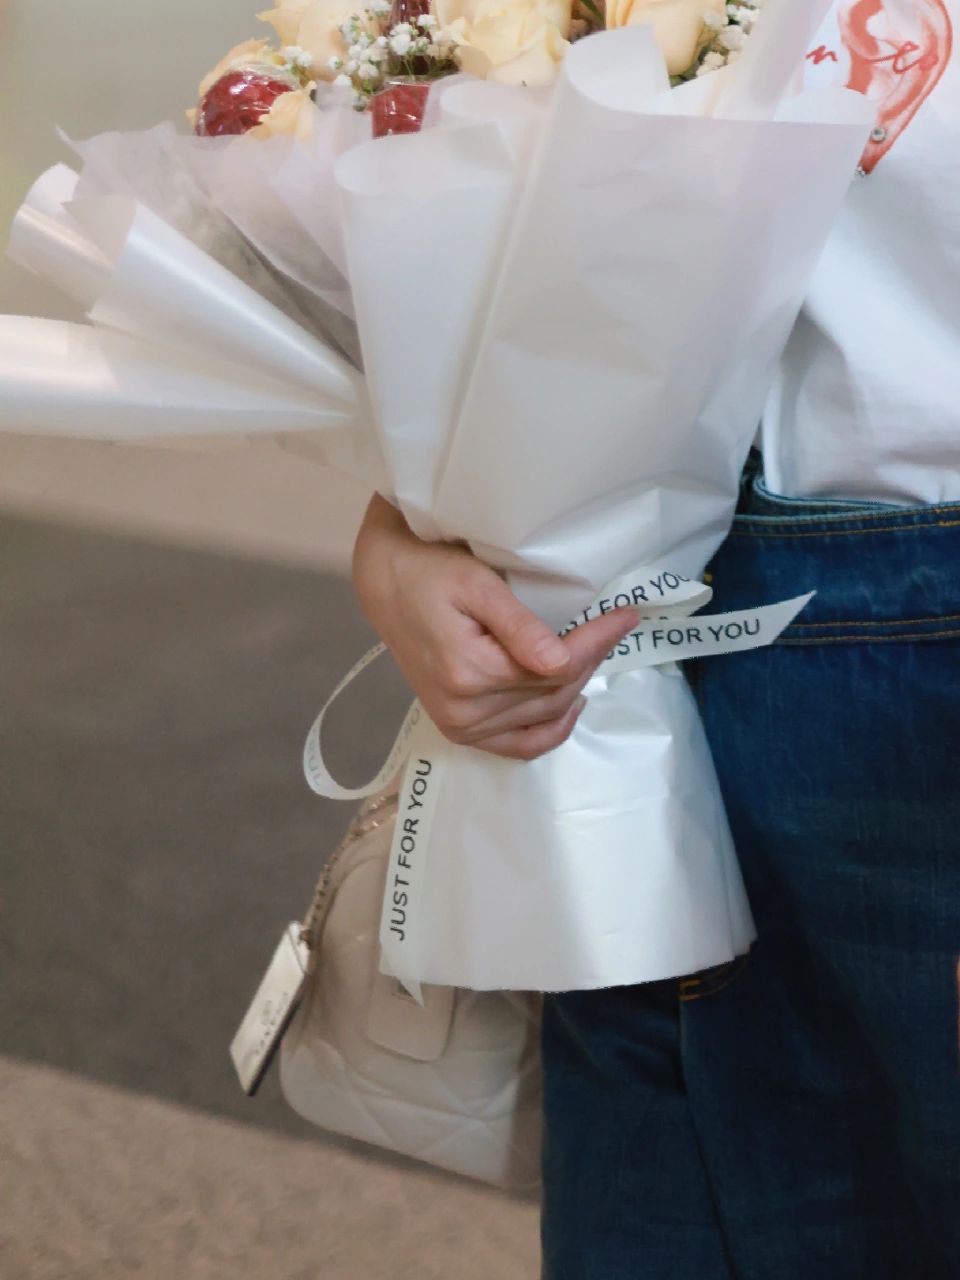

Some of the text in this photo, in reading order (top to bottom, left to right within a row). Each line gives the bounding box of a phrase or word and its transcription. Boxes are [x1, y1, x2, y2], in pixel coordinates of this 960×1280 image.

[652, 628, 702, 650] FOR
[708, 618, 761, 643] YOU
[389, 758, 433, 942] JUST FOR YOU
